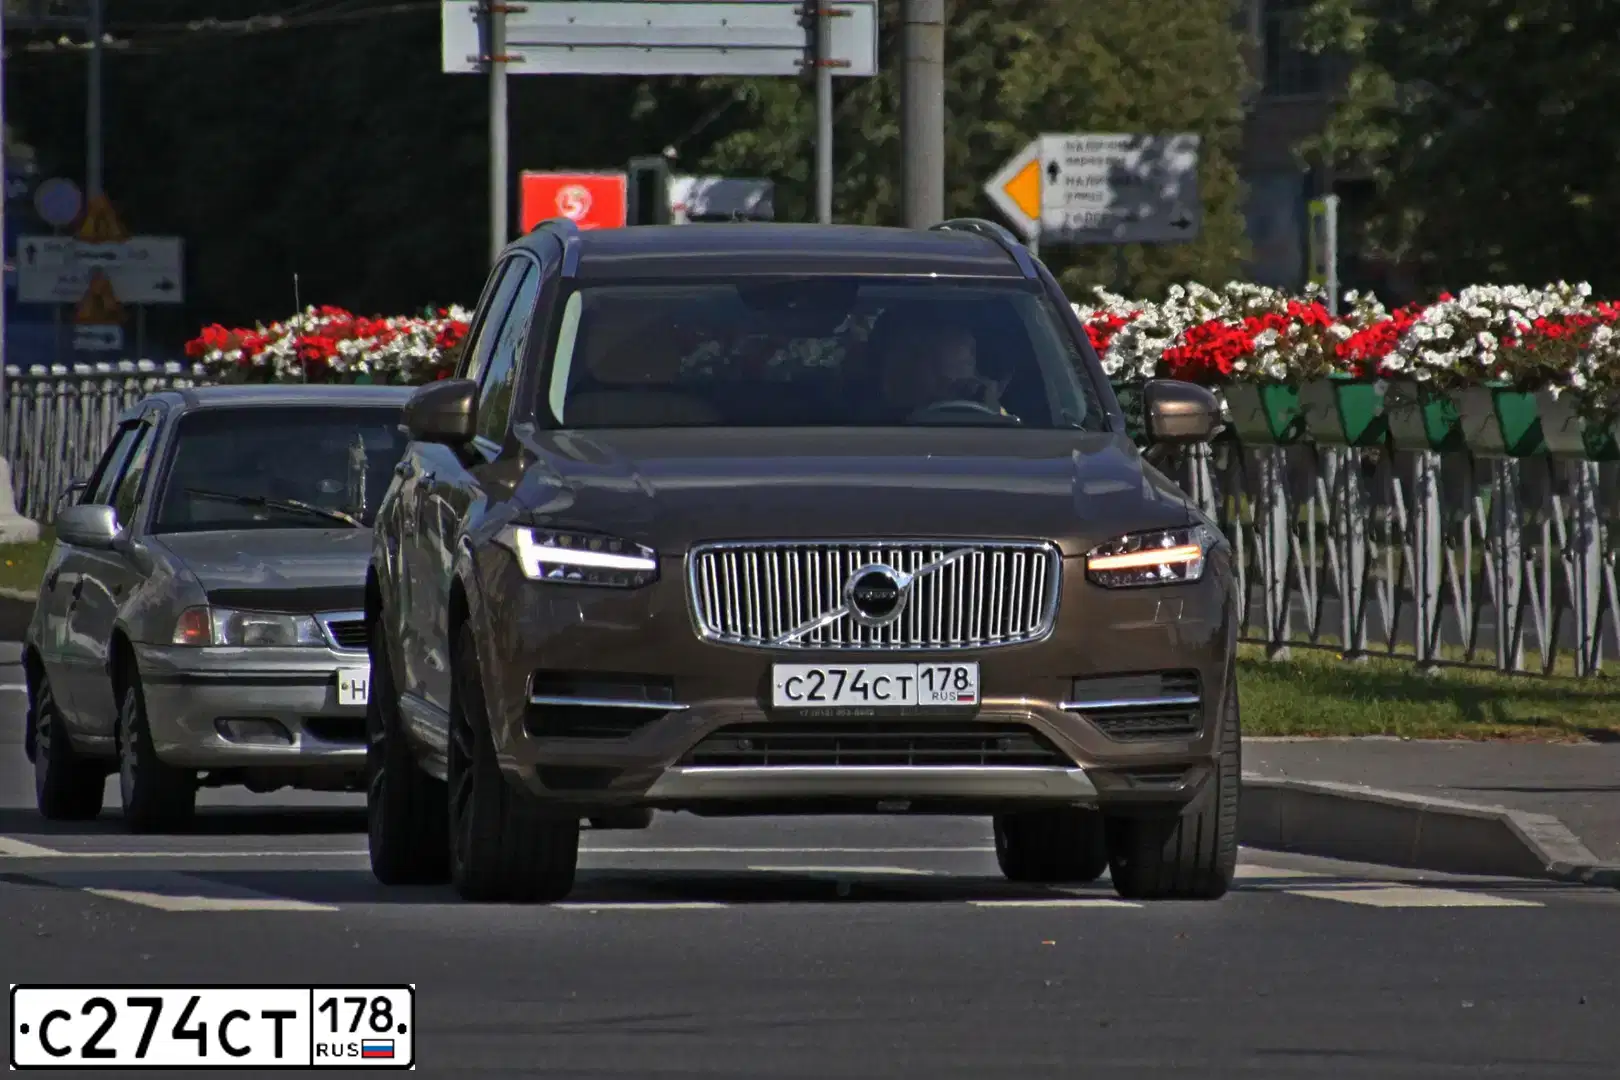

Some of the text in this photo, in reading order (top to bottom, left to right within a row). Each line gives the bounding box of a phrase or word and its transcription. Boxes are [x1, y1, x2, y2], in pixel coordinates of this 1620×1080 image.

[785, 667, 969, 701] С274СТ 178
[931, 691, 956, 701] RUS
